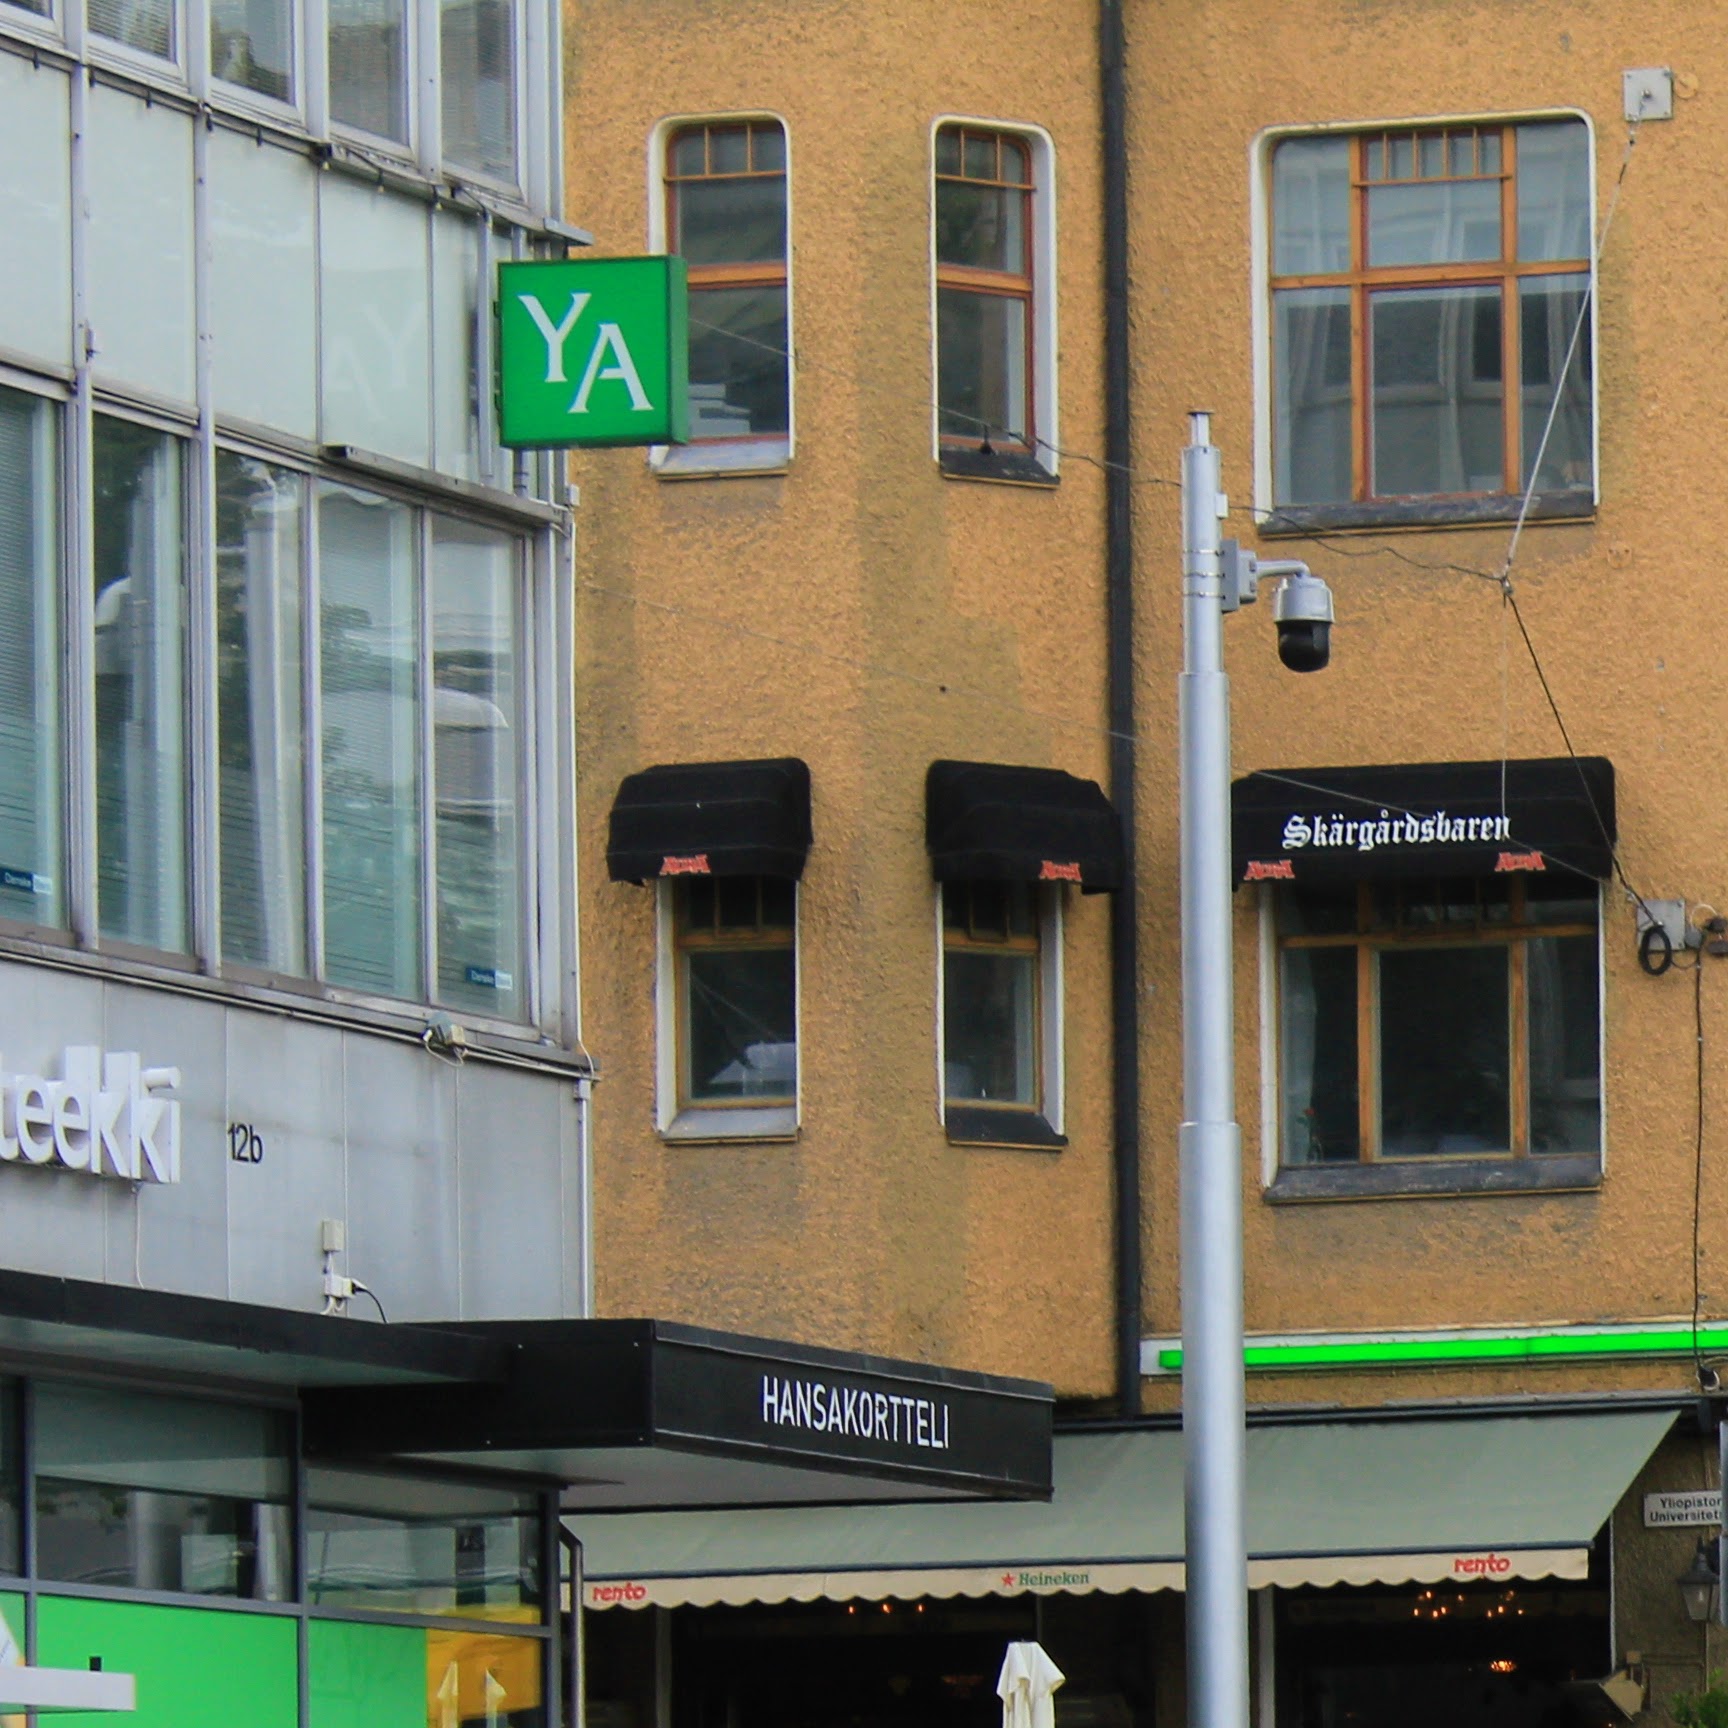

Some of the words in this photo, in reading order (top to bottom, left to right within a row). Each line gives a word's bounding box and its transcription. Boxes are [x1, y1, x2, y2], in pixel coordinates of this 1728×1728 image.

[517, 292, 654, 414] YA
[1281, 808, 1511, 852] Skärgårdsbaren
[226, 1122, 264, 1165] 12b
[762, 1374, 949, 1449] HANSAKORTTELI
[1019, 1571, 1090, 1586] Heineken
[1453, 1553, 1511, 1574] rento
[592, 1581, 648, 1602] rento
